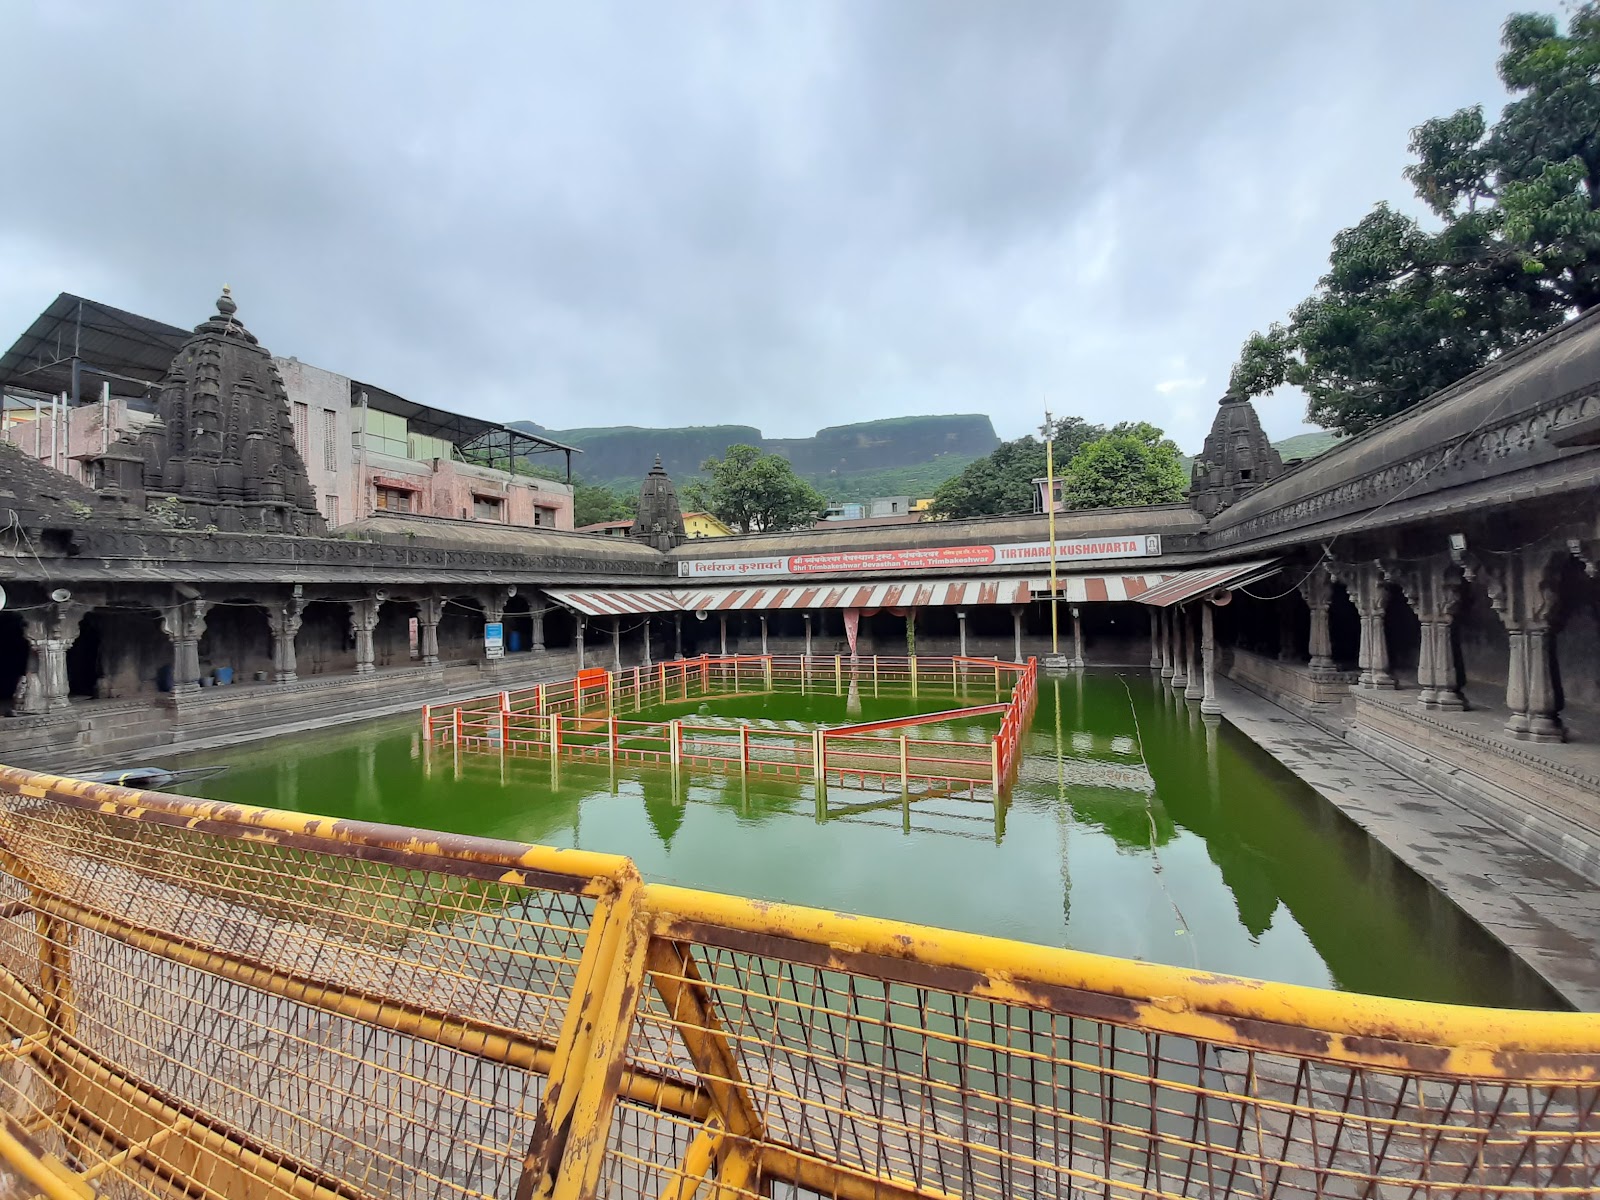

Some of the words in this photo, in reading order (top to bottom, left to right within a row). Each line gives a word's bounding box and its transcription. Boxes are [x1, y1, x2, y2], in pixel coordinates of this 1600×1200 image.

[1060, 541, 1137, 556] KUSHAVARTA
[695, 560, 735, 572] तिर्थराज
[738, 559, 782, 573] कुशावर्त
[808, 563, 861, 571] Trimbakeshwar
[927, 556, 989, 565] Trimbakeshwar
